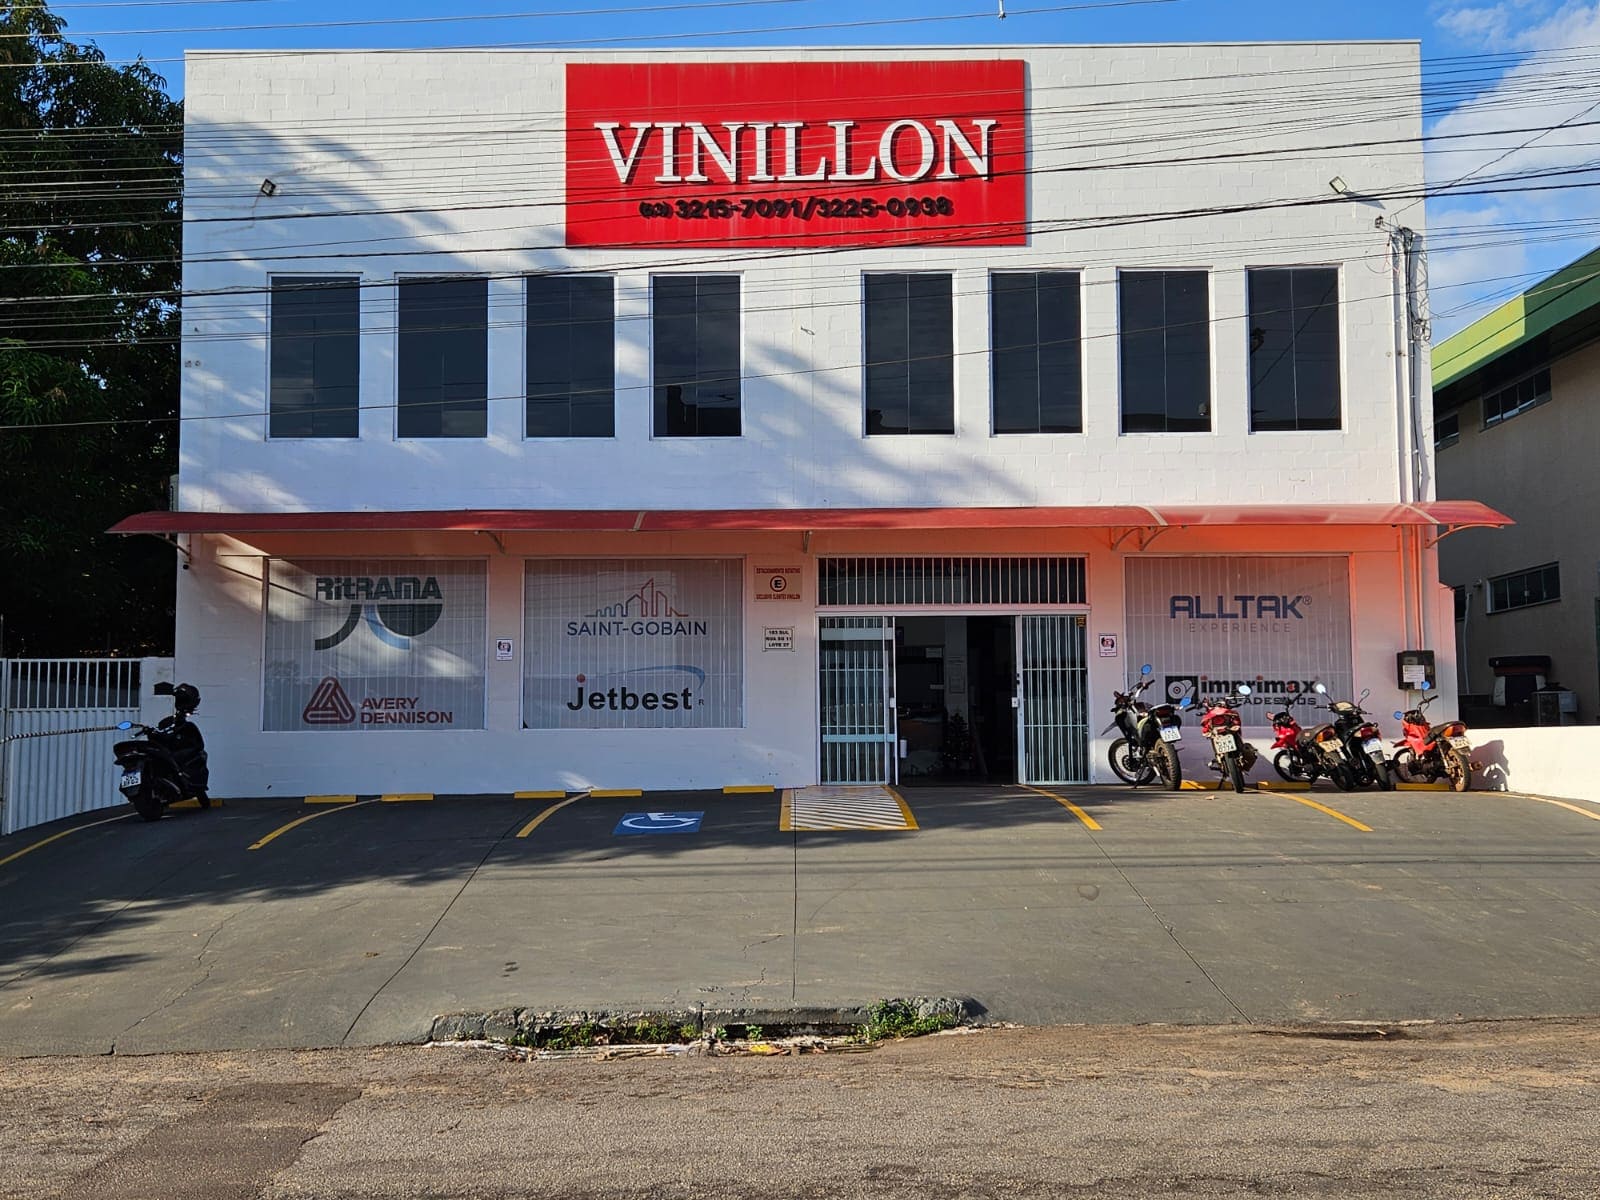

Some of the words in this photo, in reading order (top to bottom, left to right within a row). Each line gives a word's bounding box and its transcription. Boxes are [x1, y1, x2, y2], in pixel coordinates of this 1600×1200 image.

[594, 119, 997, 184] VINILLON
[567, 621, 707, 636] SAINT-GOBAIN
[1189, 622, 1292, 633] EXPERIENCE
[567, 673, 692, 711] jetbest
[361, 697, 420, 709] AVERY
[361, 711, 453, 724] DENNISON
